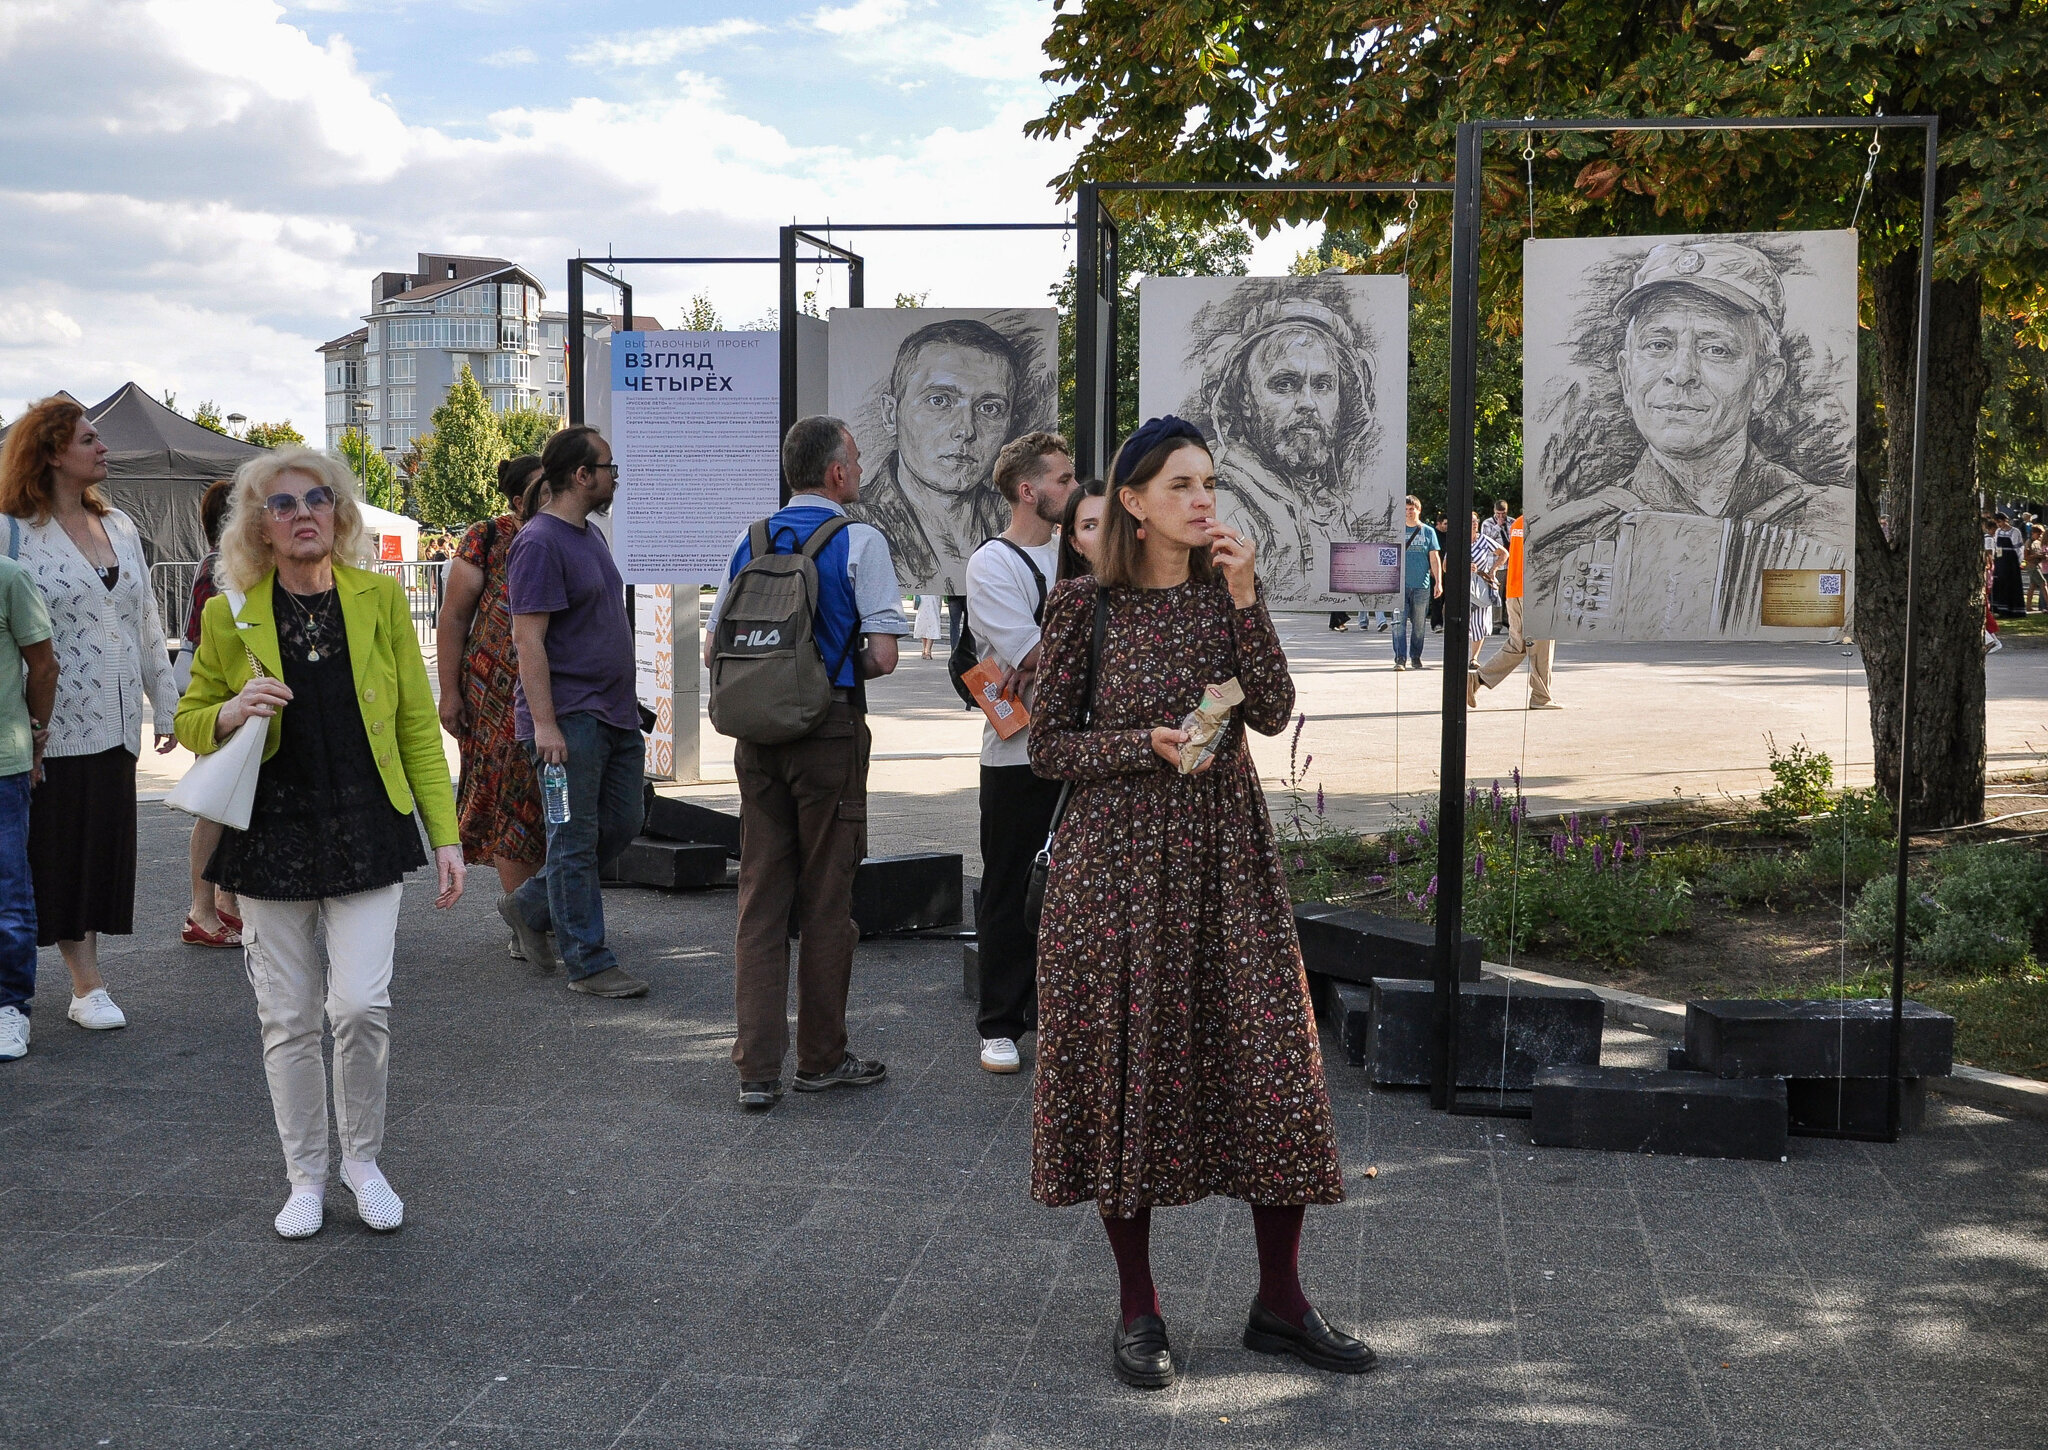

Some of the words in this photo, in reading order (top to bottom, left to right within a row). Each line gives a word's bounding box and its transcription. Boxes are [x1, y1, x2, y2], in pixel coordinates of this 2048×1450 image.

[717, 340, 760, 348] ПРОЕКТ
[625, 353, 713, 370] ВЗГЛЯД
[625, 373, 733, 391] ЧЕТЫРЁХ
[734, 629, 781, 647] FILA
